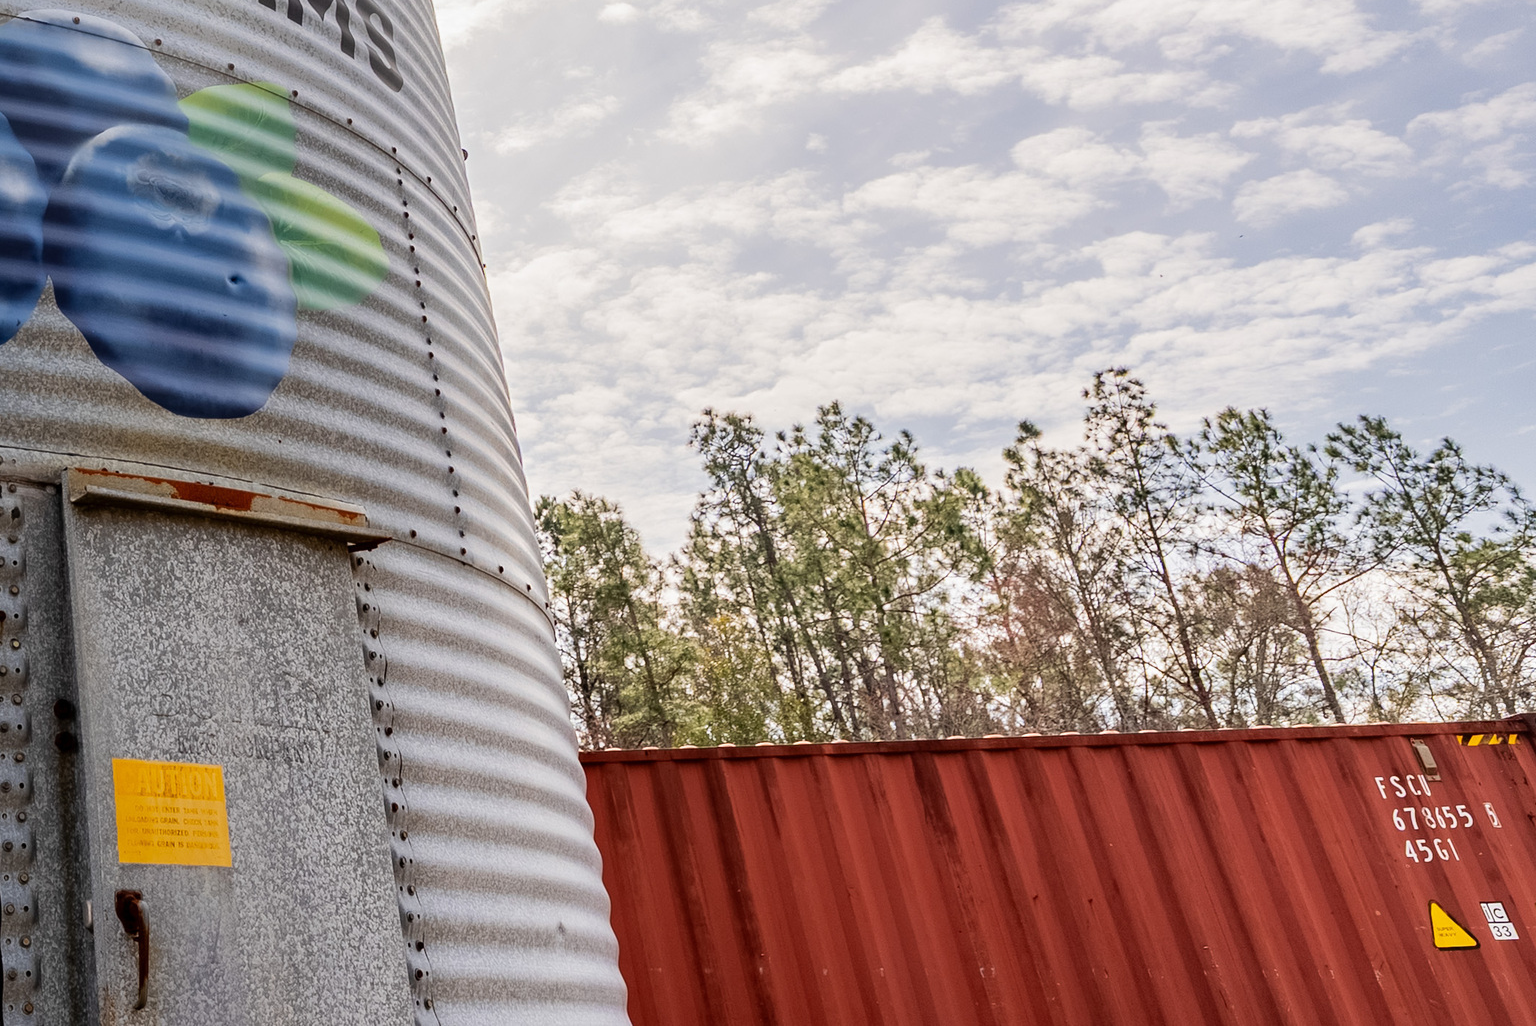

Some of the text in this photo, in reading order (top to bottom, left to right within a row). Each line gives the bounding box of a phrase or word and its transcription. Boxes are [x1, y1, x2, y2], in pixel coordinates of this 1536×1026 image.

[1374, 774, 1432, 800] FSCU
[1392, 804, 1474, 832] 678655
[1405, 837, 1460, 863] 45G1
[1492, 925, 1513, 938] 33
